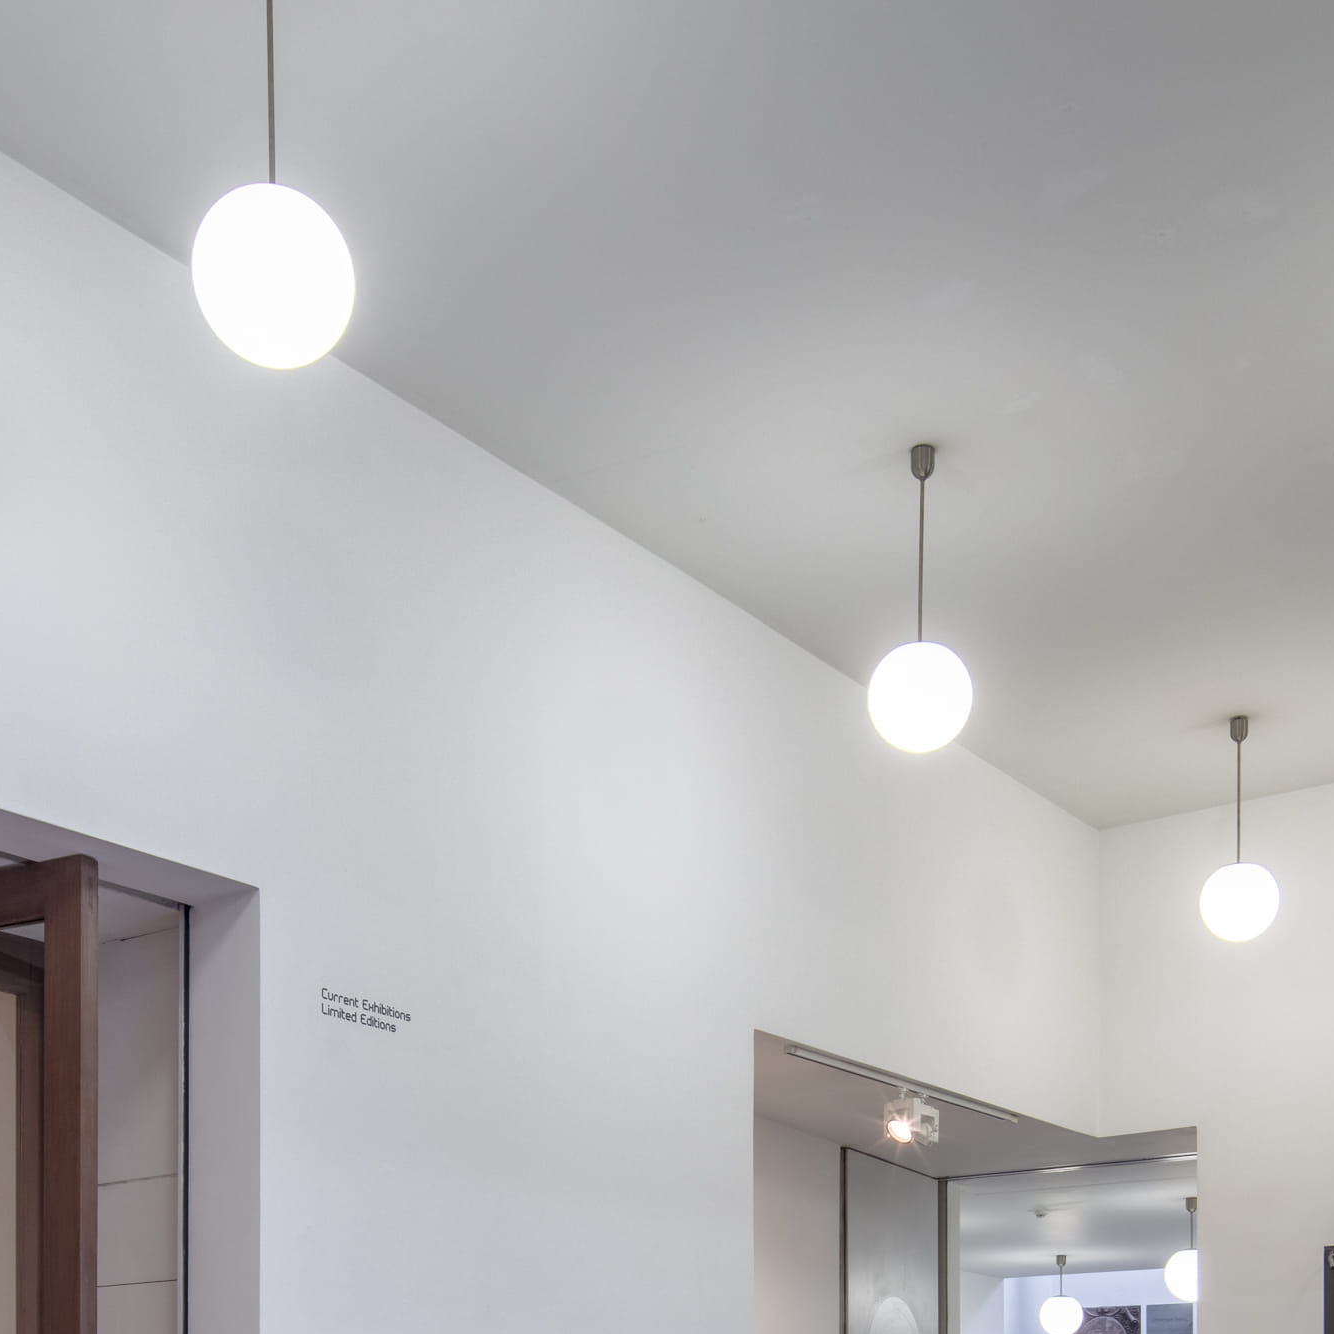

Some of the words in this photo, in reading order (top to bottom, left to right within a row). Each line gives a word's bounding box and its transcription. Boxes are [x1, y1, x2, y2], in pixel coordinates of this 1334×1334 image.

[321, 987, 359, 1008] Current
[362, 999, 411, 1022] Exhibitions
[321, 1003, 357, 1023] Limited
[360, 1014, 397, 1033] Editions
